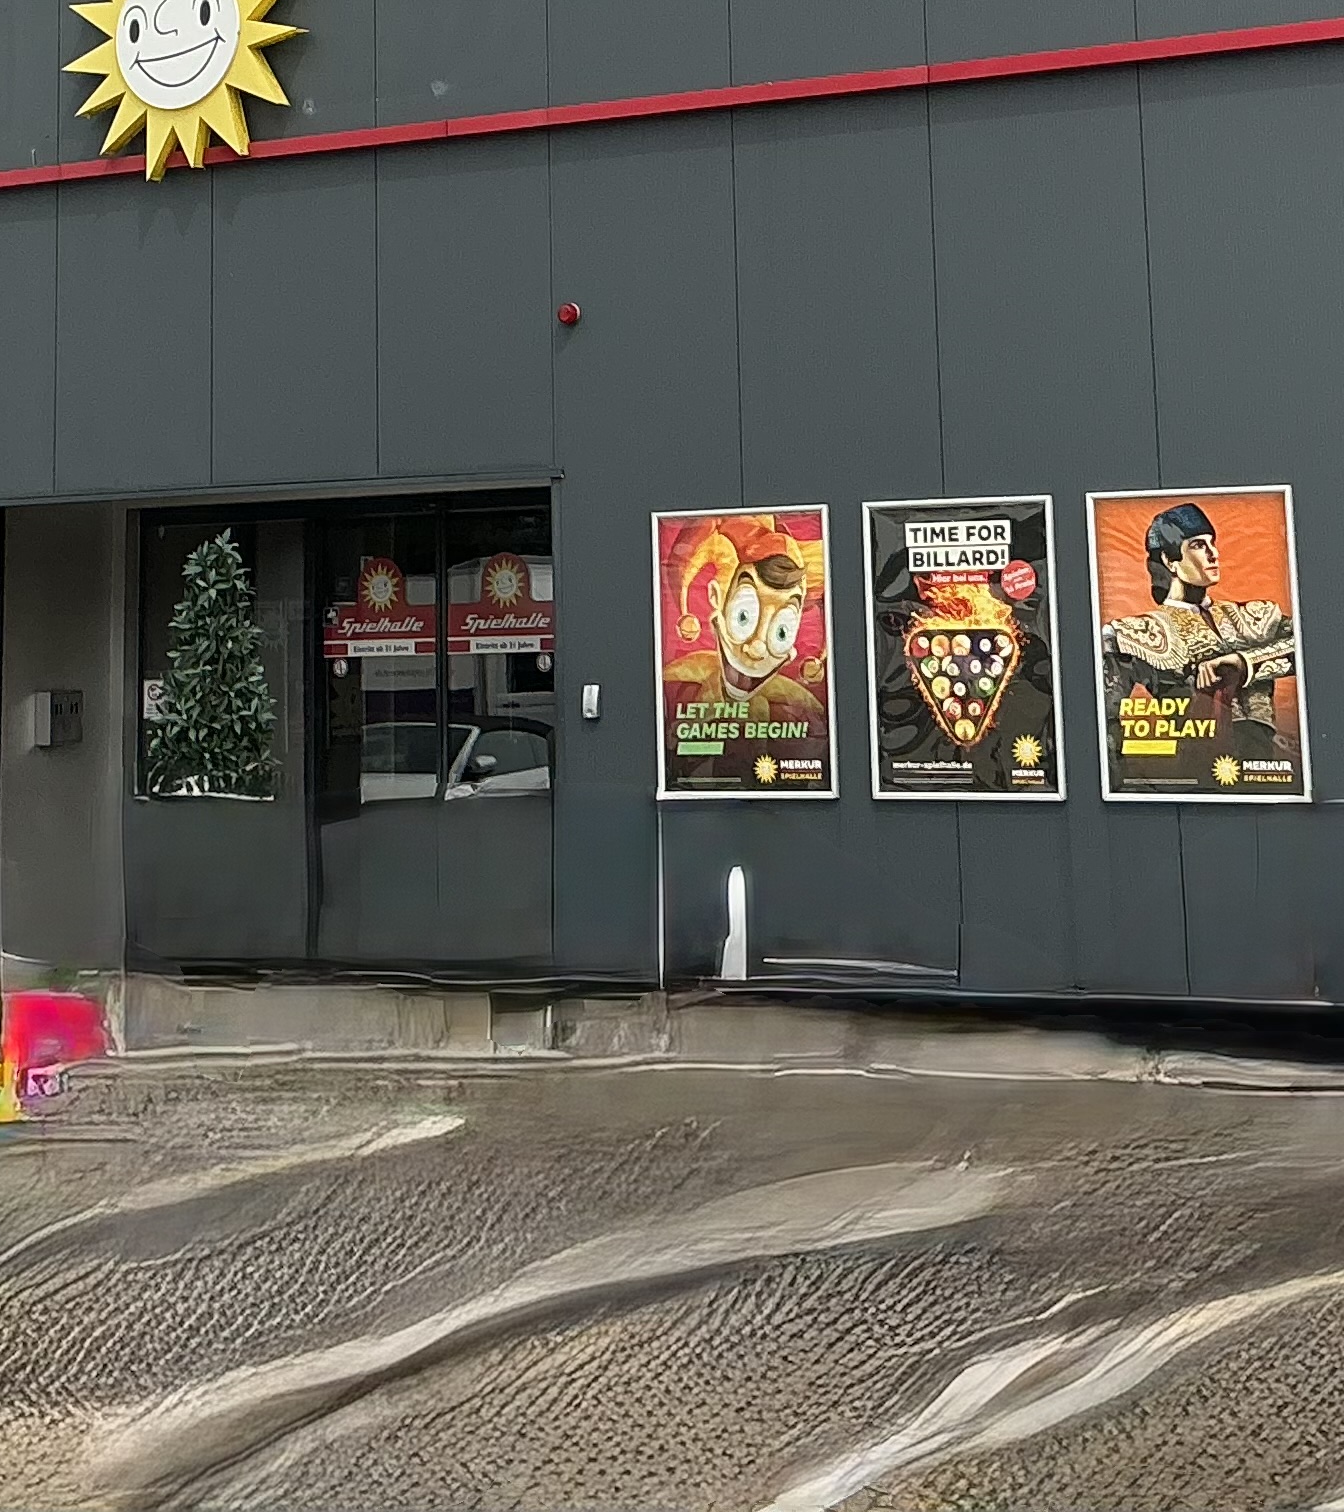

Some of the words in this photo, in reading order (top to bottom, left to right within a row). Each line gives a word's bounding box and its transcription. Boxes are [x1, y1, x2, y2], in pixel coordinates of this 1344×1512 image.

[909, 526, 959, 544] TIME
[966, 524, 1006, 542] FOR
[912, 549, 1005, 568] BILLARD!
[338, 617, 424, 637] Spielhalle
[461, 613, 551, 634] Spielhalle
[676, 702, 709, 719] LET
[713, 702, 750, 719] THE
[1119, 698, 1190, 716] READY
[676, 722, 740, 739] GAMES
[744, 721, 809, 738] BEGIN!
[1122, 720, 1150, 737] TO
[1155, 719, 1217, 738] PLAY!
[779, 759, 822, 770] MERKUR
[1243, 760, 1293, 772] MERKUR
